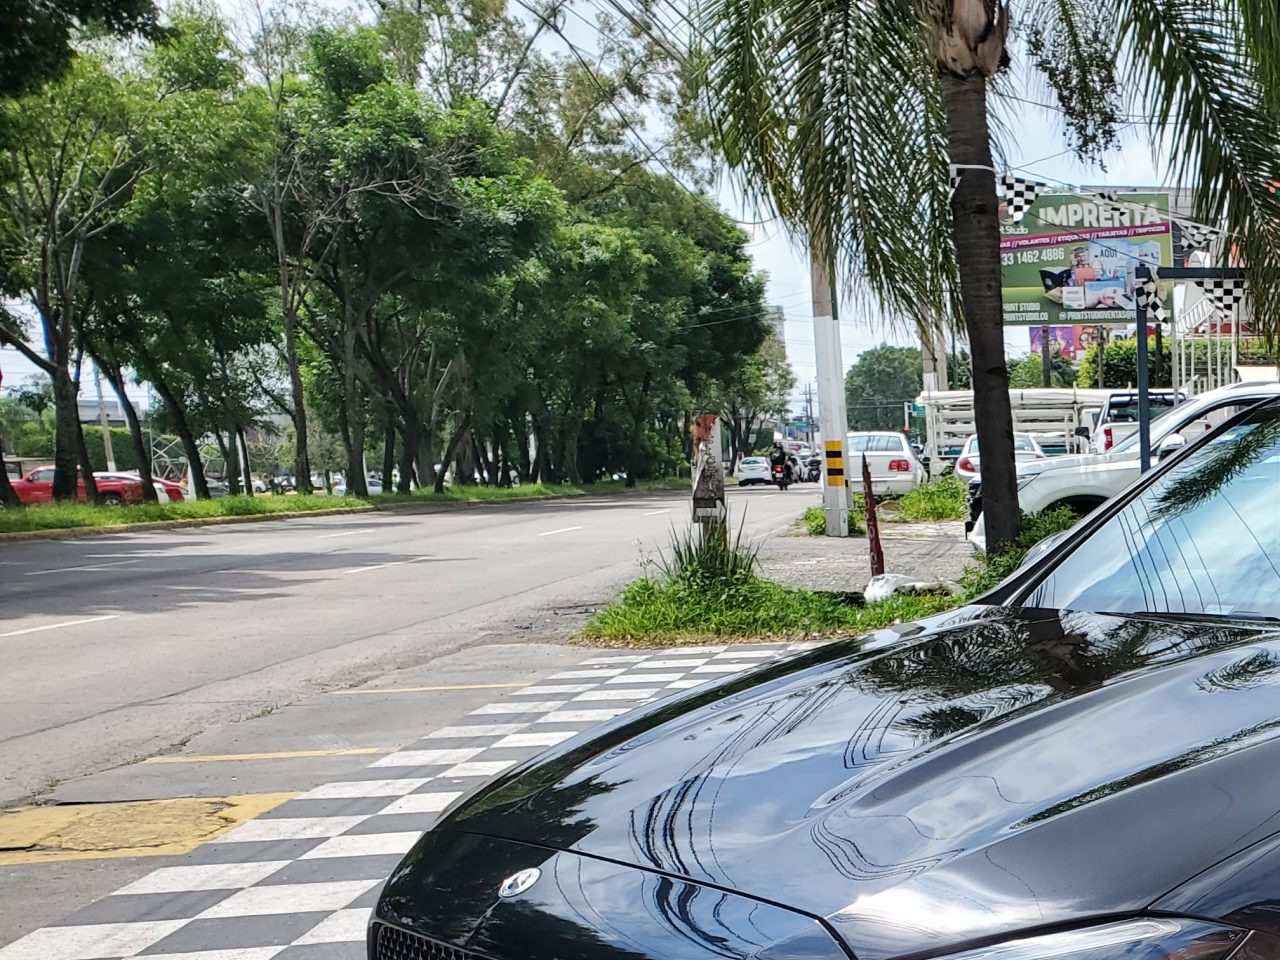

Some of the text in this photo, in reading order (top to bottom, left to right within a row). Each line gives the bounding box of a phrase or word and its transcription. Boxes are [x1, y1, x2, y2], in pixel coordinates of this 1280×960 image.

[1038, 202, 1162, 229] IMPRENTA
[1016, 250, 1040, 265] 1462
[1040, 248, 1065, 262] 4886
